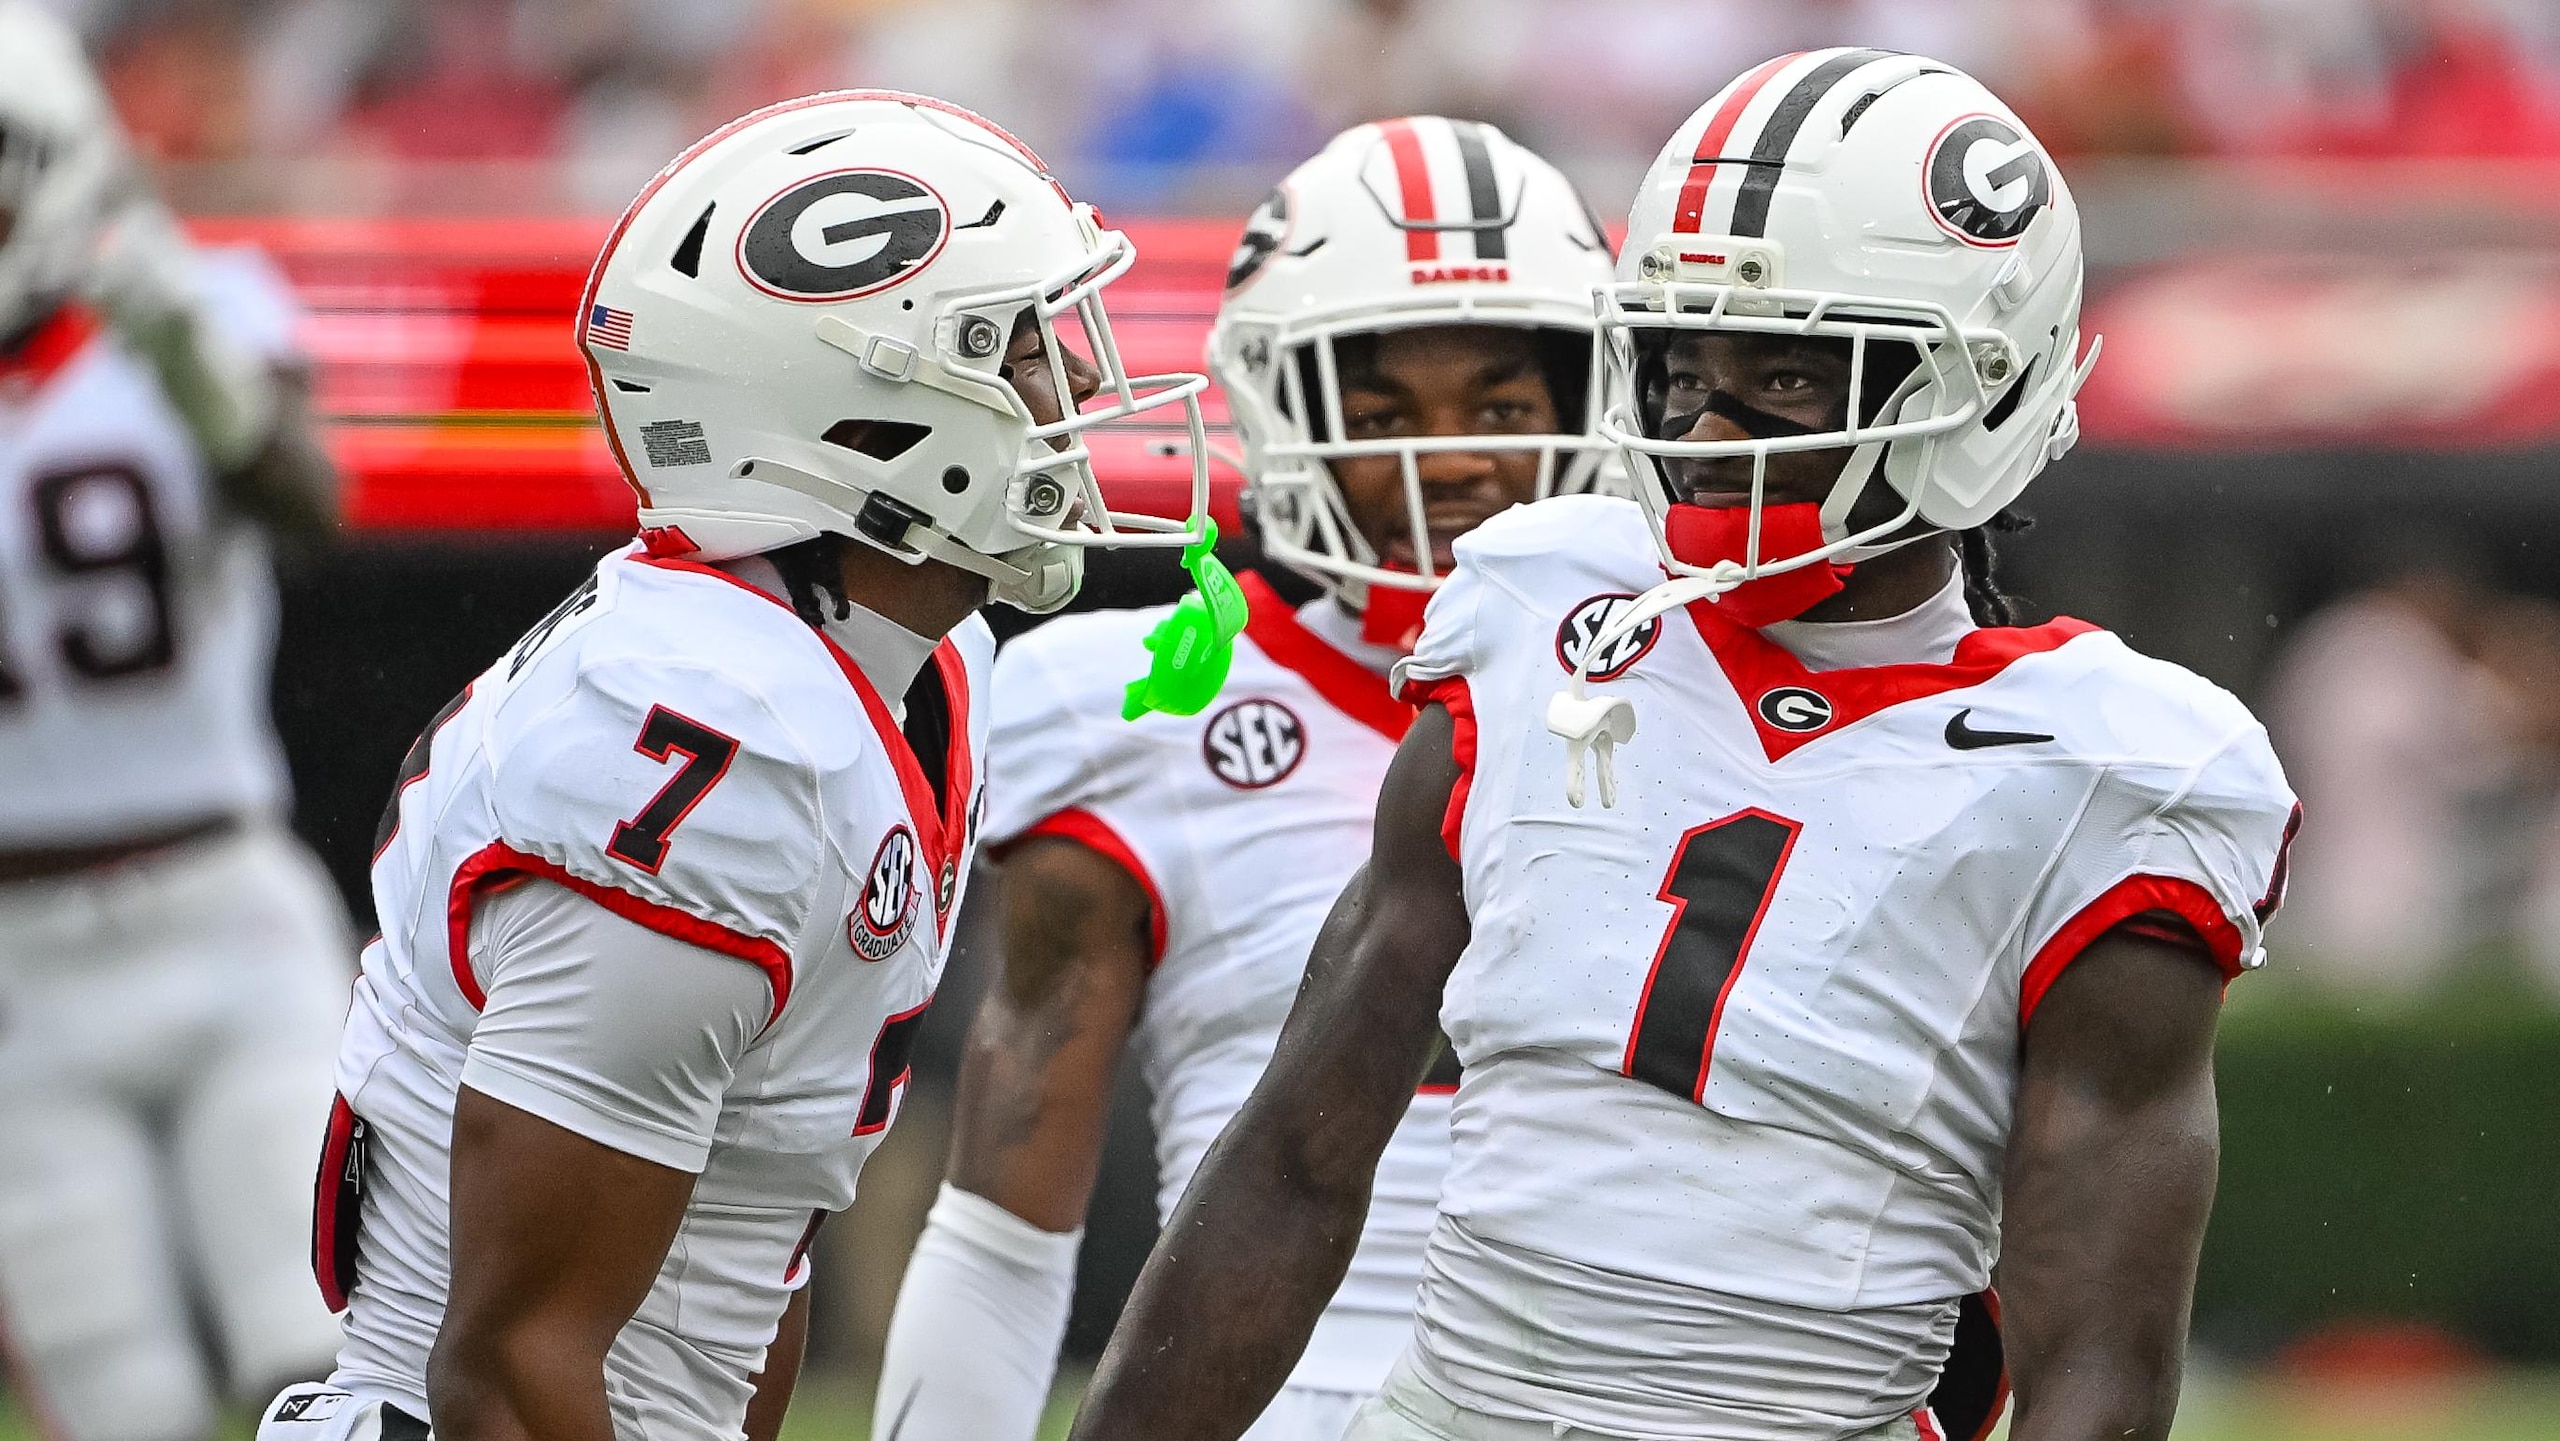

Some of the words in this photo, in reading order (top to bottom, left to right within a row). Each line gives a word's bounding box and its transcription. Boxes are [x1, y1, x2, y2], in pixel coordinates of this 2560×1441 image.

[744, 173, 942, 293] G
[1410, 267, 1508, 285] DAWGS
[0, 462, 175, 712] 9
[1209, 705, 1298, 783] SEC
[1760, 689, 1830, 730] G
[605, 703, 740, 875] 7
[867, 832, 912, 926] SEC
[854, 913, 913, 957] GRADUATE
[1622, 806, 1802, 1106] 1
